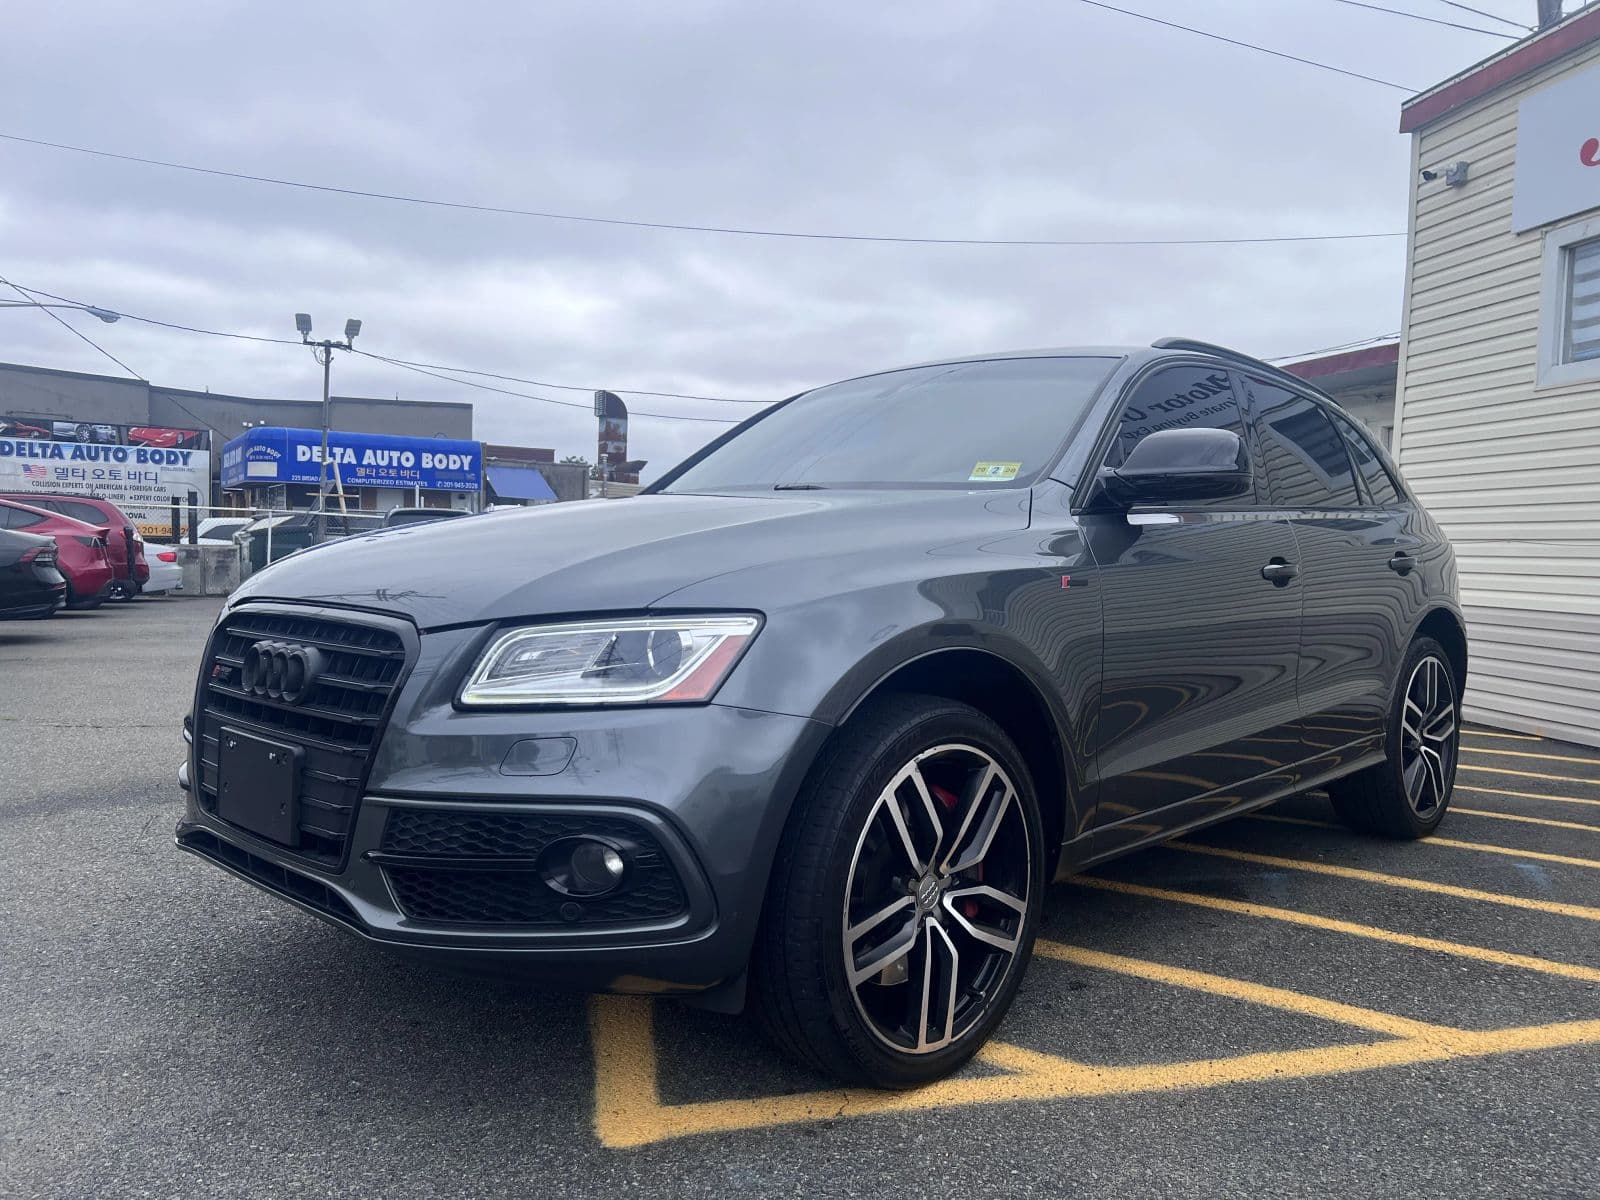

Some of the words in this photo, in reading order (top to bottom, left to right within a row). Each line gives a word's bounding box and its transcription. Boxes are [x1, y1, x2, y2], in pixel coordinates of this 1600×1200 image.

[0, 441, 64, 460] DELTA
[71, 445, 128, 463] AUTO
[136, 448, 192, 466] BODY
[296, 445, 357, 465] DELTA
[362, 449, 415, 467] AUTO
[421, 452, 473, 471] BODY
[378, 468, 398, 477] 오토
[400, 469, 420, 479] 바디
[991, 466, 1000, 474] 2
[92, 468, 123, 481] 오토
[127, 470, 158, 484] 바디
[346, 477, 394, 486] COMPUTERIZED
[31, 480, 61, 488] COLLISION
[62, 481, 84, 489] EXPERTS
